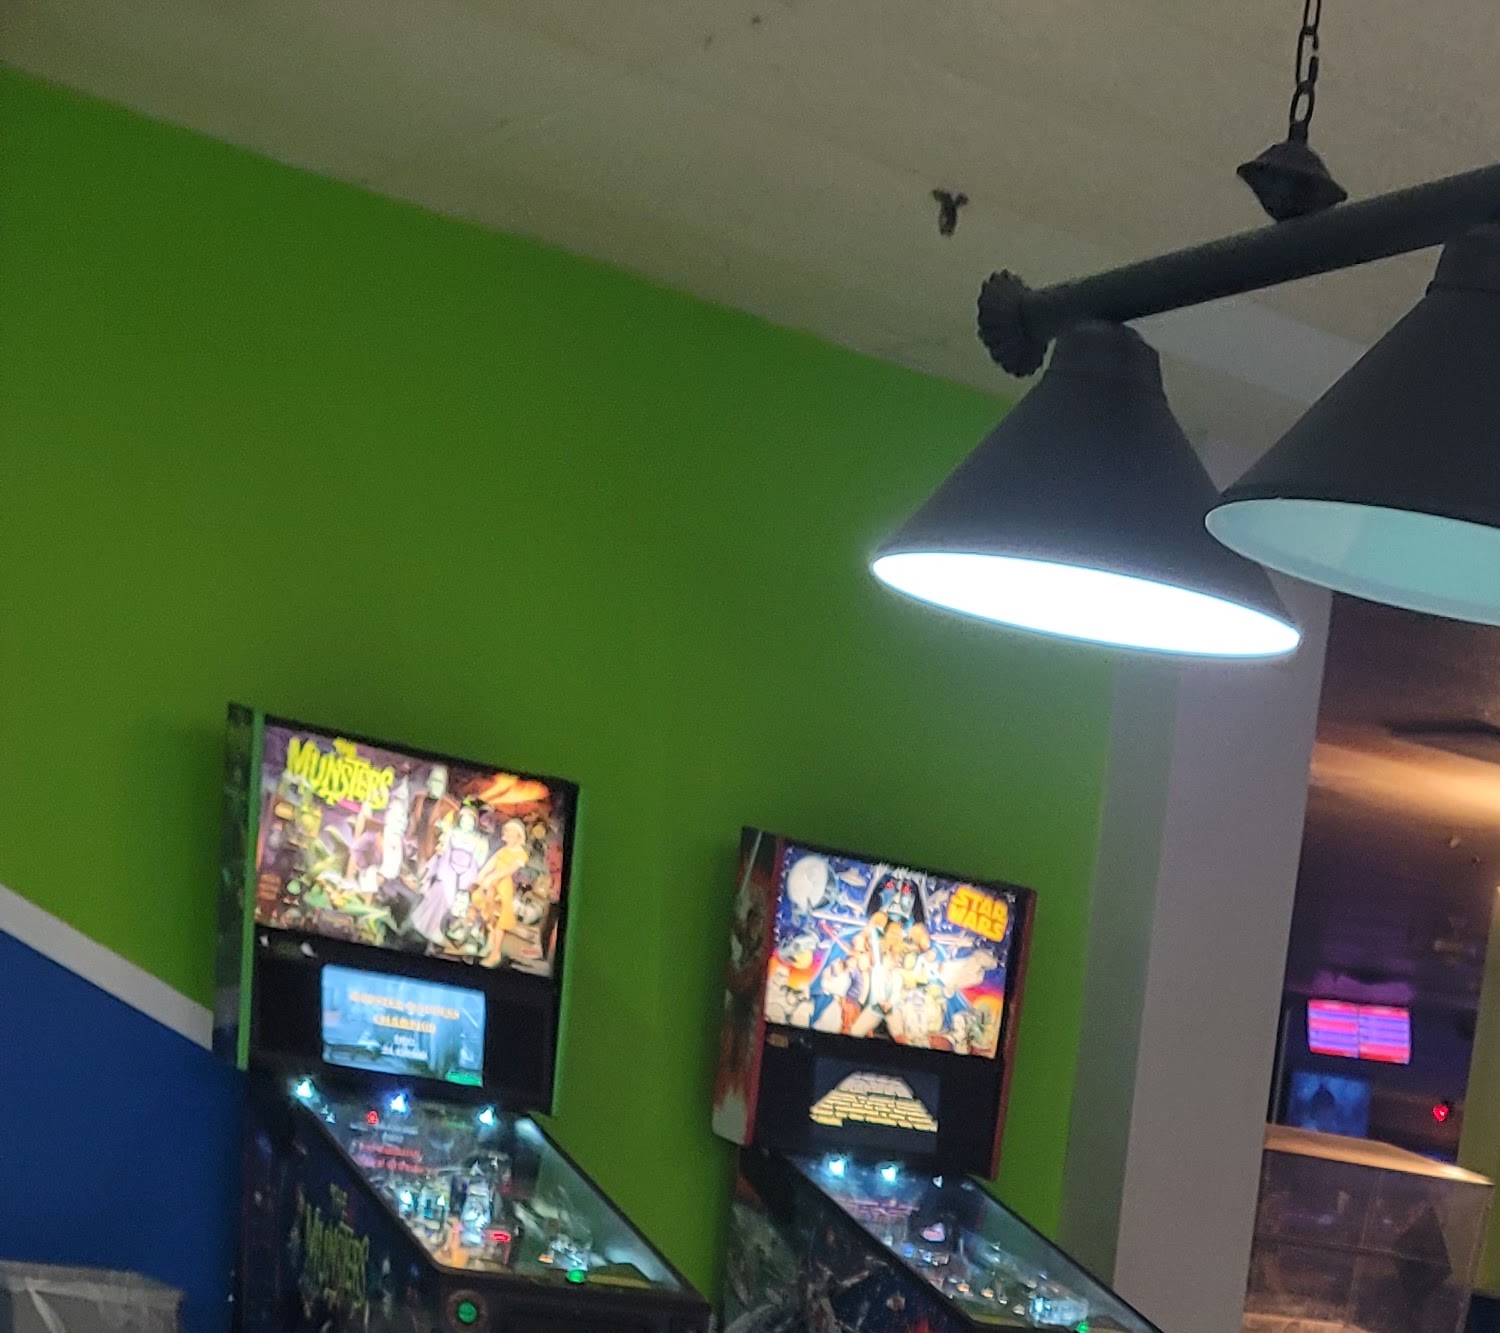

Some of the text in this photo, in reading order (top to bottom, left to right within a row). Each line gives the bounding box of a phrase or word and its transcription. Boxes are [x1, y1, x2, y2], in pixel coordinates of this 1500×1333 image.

[287, 736, 395, 810] MUNSTERS
[947, 902, 1004, 942] WARS
[950, 884, 1008, 924] STAR
